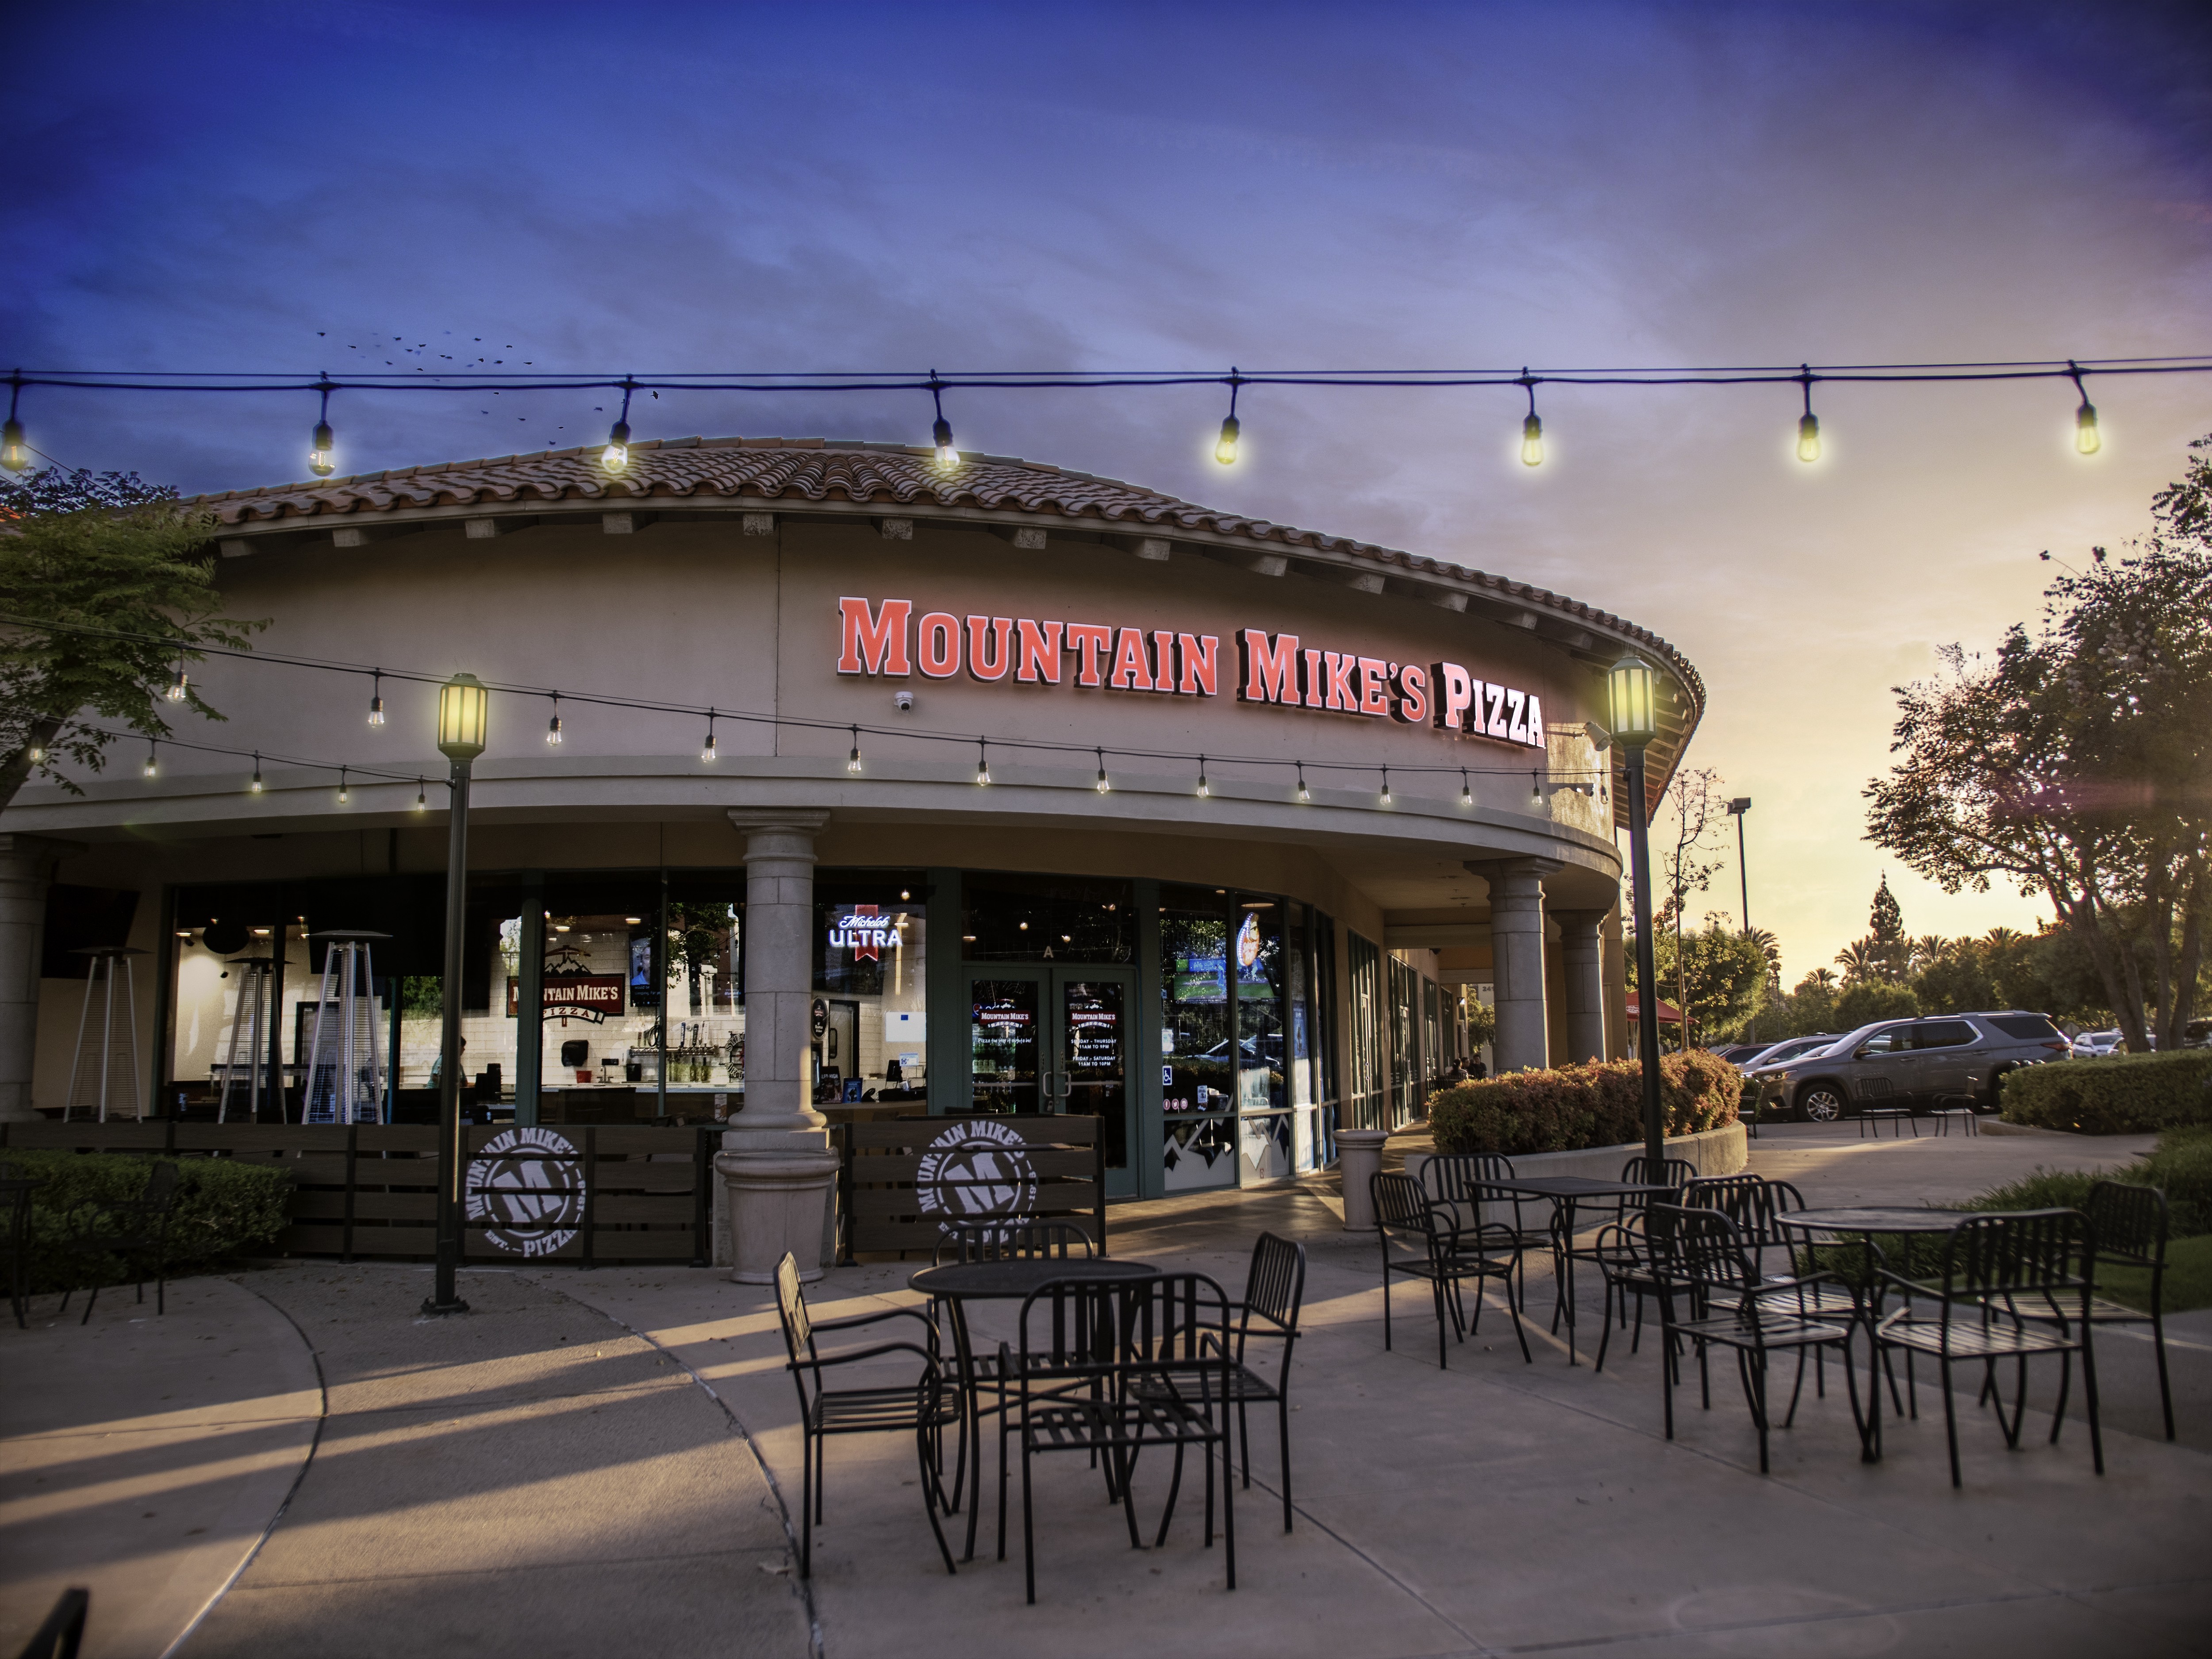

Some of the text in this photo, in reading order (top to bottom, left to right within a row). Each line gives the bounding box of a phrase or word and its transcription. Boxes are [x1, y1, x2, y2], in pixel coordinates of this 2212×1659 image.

[838, 596, 1547, 749] MOUNTAIN MIKE'S PIZZA
[839, 914, 890, 928] Michelob
[830, 929, 902, 947] ULTRA
[1043, 946, 1054, 958] A
[513, 984, 618, 1001] MNTAIN MIKE'S
[543, 1007, 589, 1018] PIZZA
